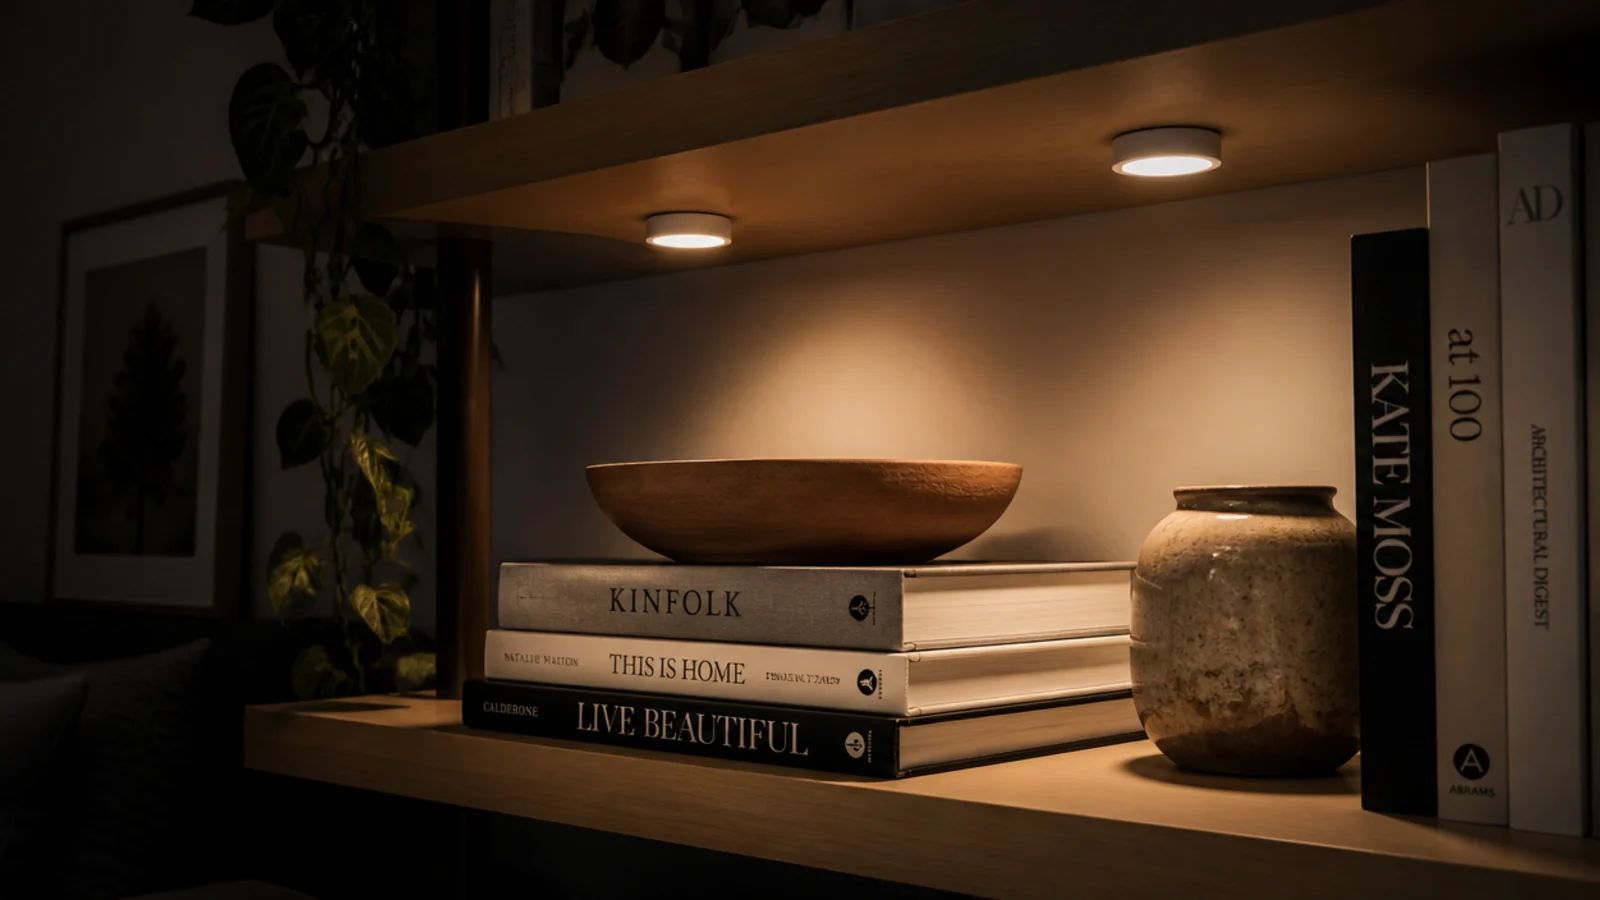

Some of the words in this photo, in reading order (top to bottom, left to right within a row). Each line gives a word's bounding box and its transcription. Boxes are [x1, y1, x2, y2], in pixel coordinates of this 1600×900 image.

[1507, 185, 1563, 225] AD
[1447, 328, 1480, 365] at
[1370, 360, 1411, 485] KATE
[1447, 373, 1483, 442] 100
[1531, 424, 1548, 565] ARCHITECTURAL
[1373, 496, 1415, 631] MOSS
[609, 587, 742, 617] KINFOLK
[1533, 567, 1550, 630] DIGEST
[609, 653, 655, 677] THIS
[659, 657, 677, 680] IS
[681, 659, 746, 685] HOME
[482, 701, 541, 719] CALDERONE
[576, 701, 636, 737] LIVE
[643, 707, 809, 757] BEAUTIFUL
